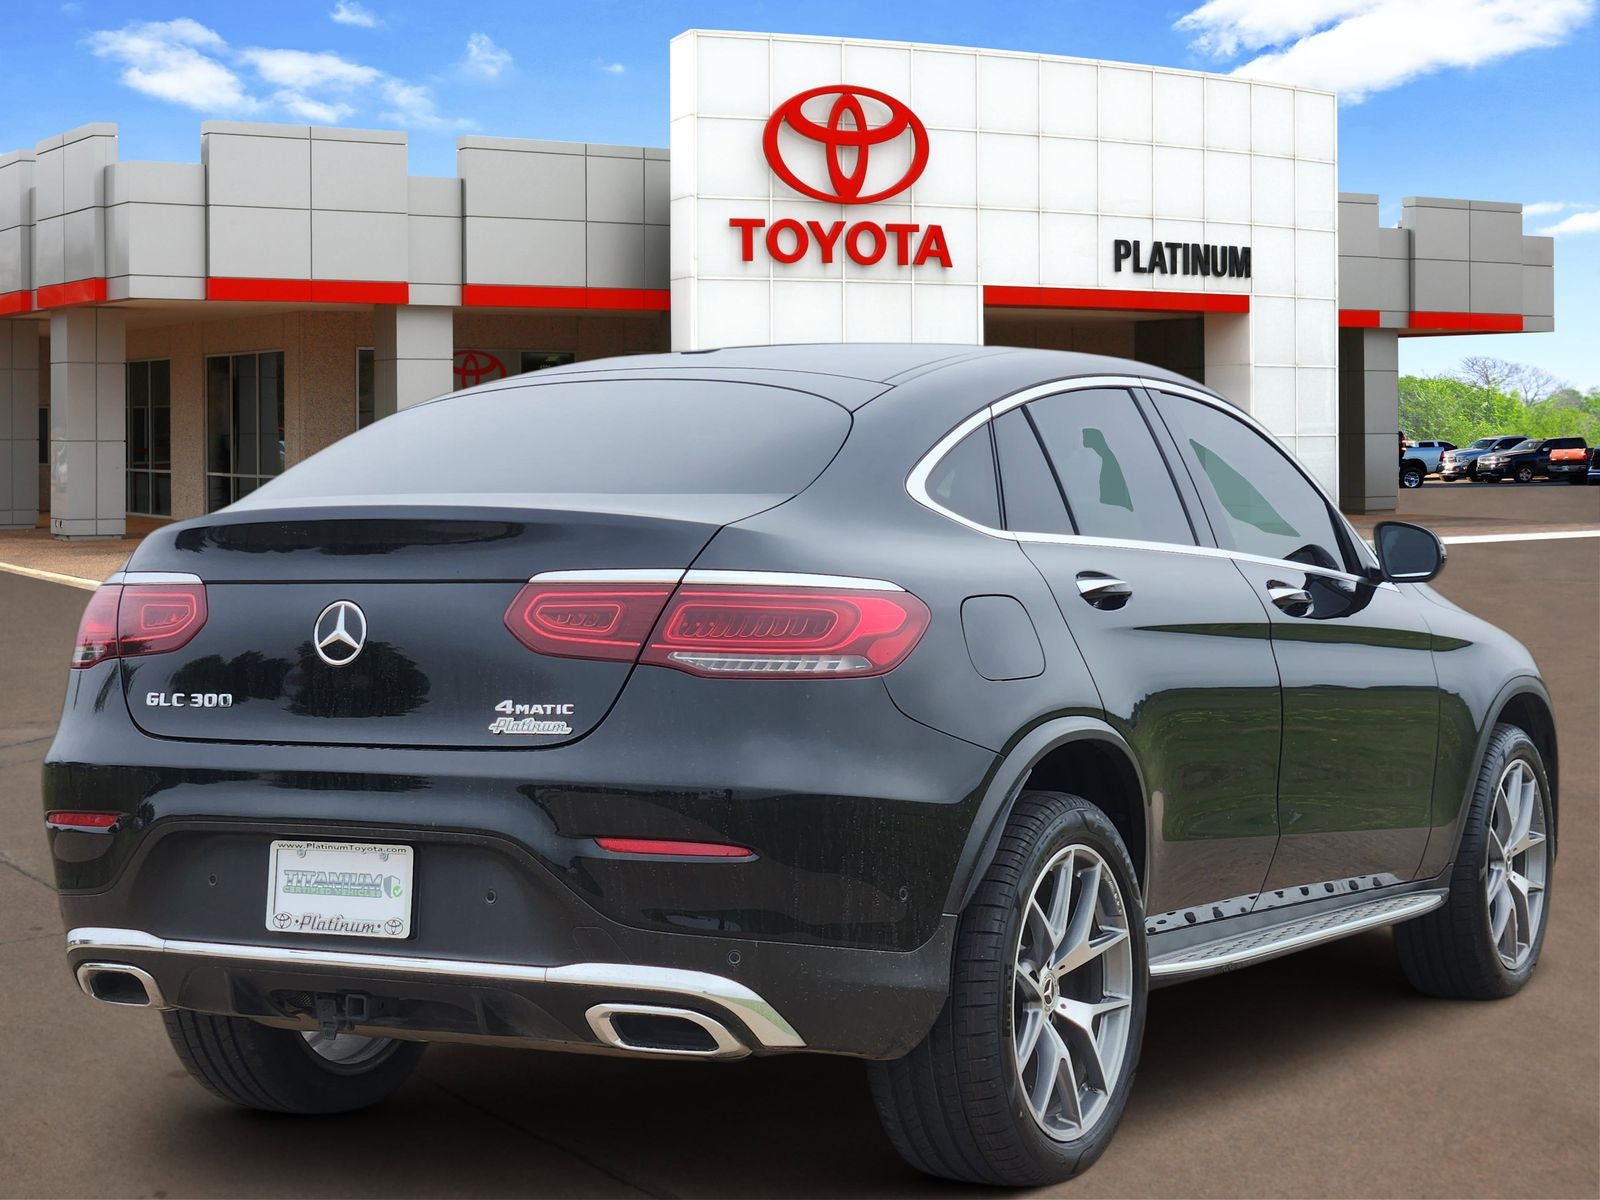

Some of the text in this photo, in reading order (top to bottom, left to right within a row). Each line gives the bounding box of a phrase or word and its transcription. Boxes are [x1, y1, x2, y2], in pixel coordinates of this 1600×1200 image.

[729, 218, 953, 268] TOYOTA
[1114, 239, 1252, 278] PLATINUM
[146, 692, 232, 707] GLC 300
[495, 700, 575, 714] 4MATIC
[488, 717, 573, 735] Platinum
[278, 843, 407, 854] www.PlatinumToyota.com
[284, 869, 383, 889] TITANIUM
[300, 913, 377, 933] Platinum
